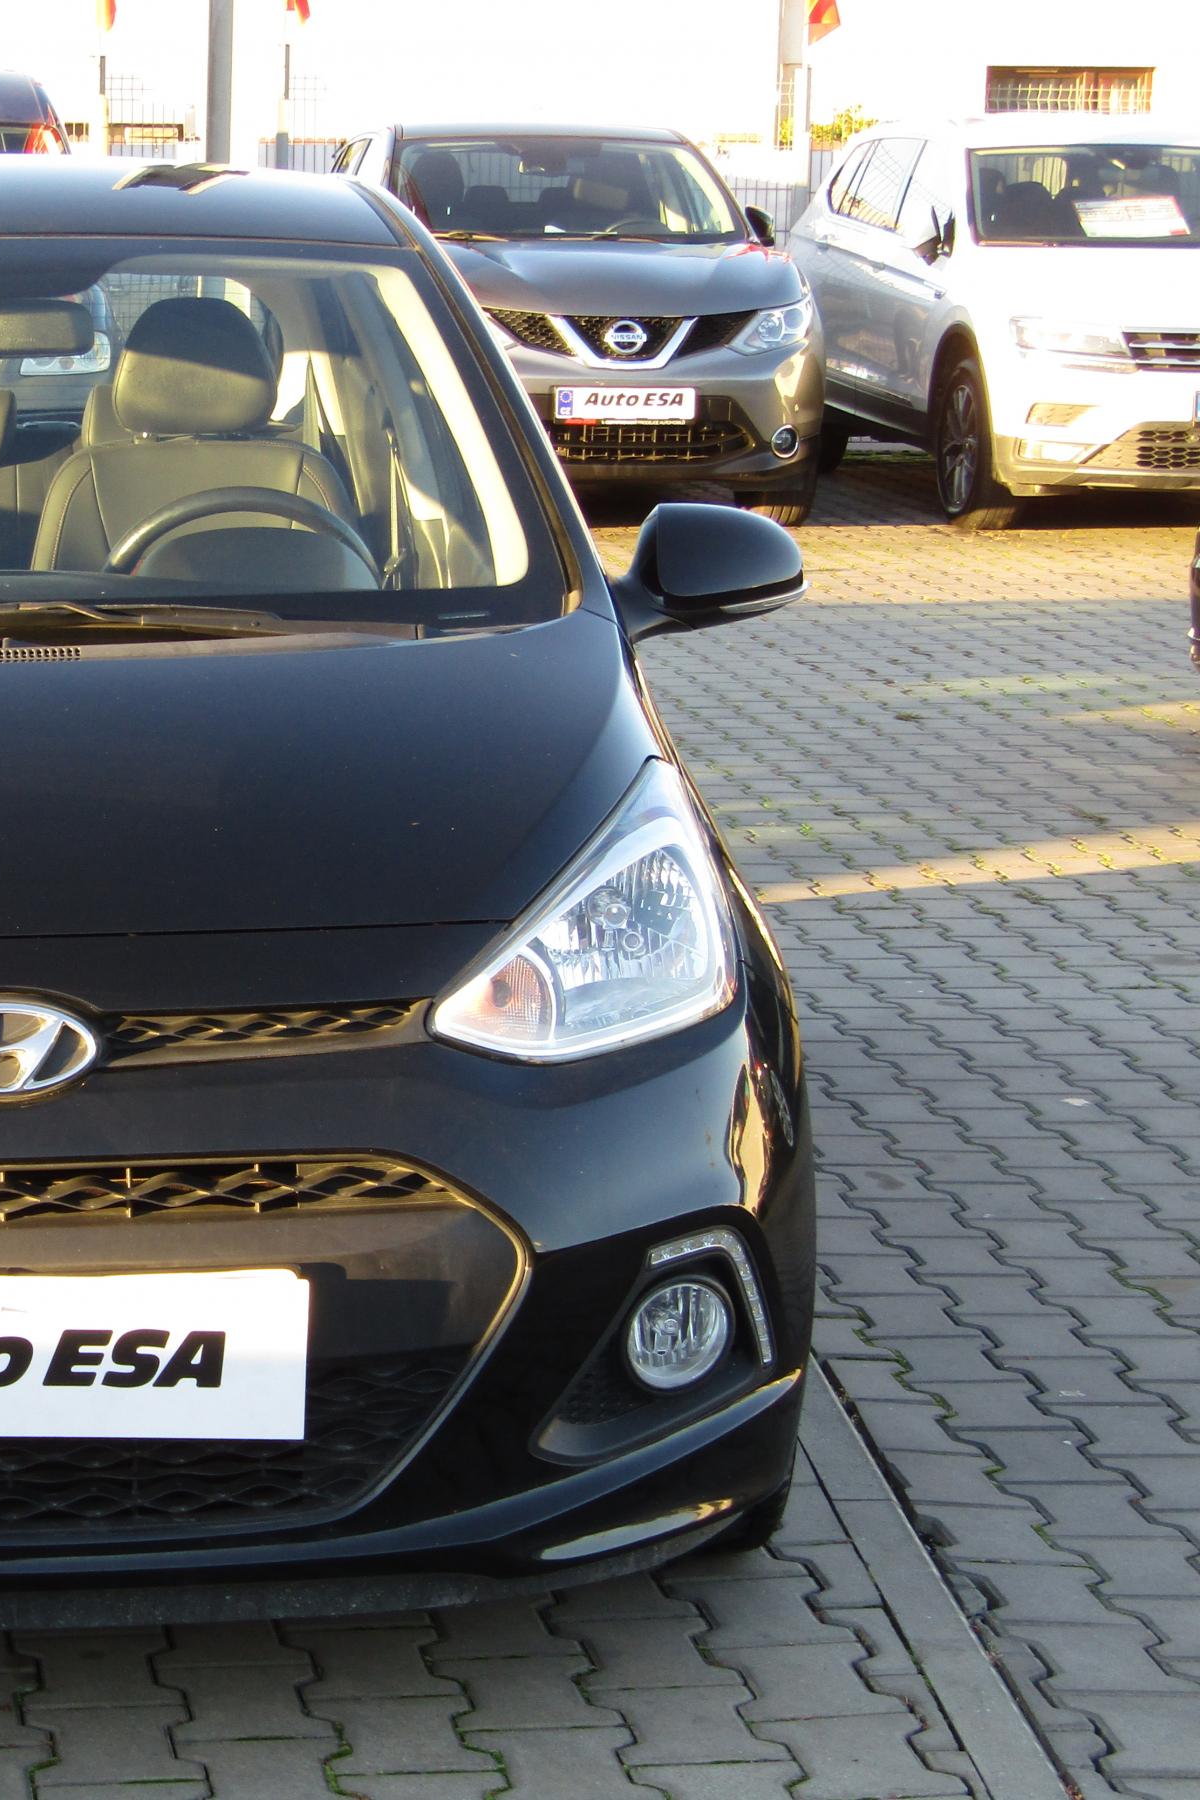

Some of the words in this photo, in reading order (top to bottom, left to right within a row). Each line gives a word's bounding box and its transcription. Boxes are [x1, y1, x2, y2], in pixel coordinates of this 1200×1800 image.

[584, 392, 640, 407] Auto
[642, 392, 684, 407] ESA
[42, 1328, 226, 1388] ESA
